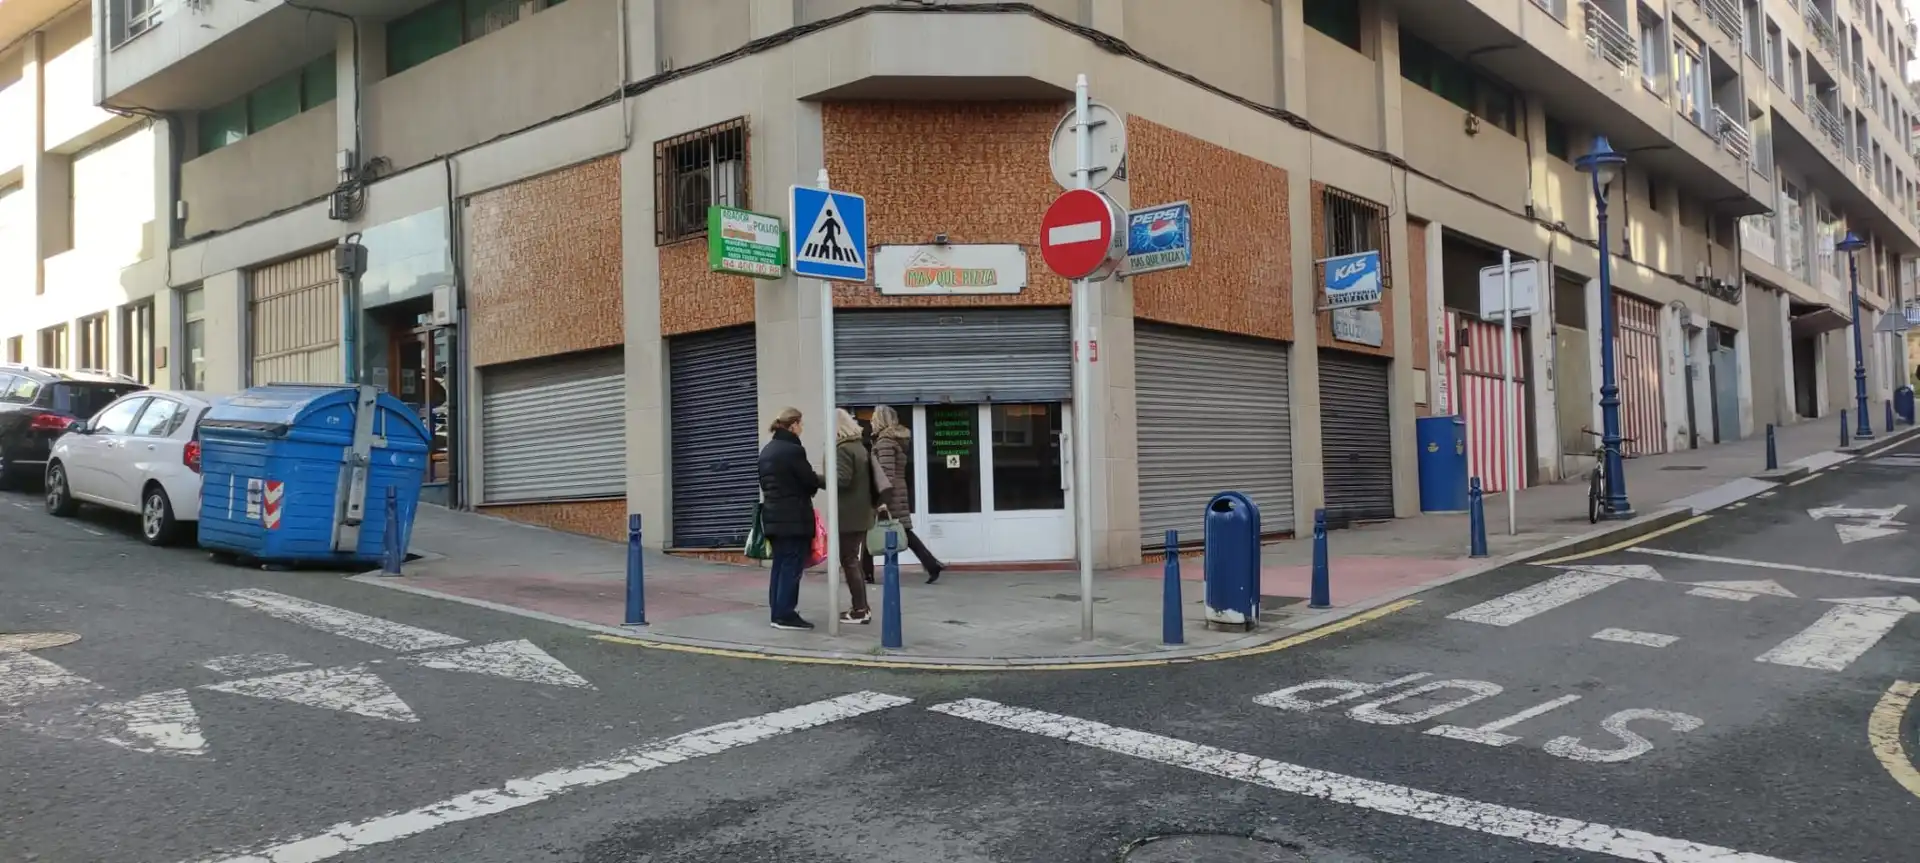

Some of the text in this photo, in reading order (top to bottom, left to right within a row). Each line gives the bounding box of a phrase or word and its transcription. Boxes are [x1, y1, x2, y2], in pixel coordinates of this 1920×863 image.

[1131, 207, 1180, 226] PEPSI
[1145, 253, 1160, 265] QUE
[908, 269, 996, 285] MAS QUE PIZZA
[1335, 258, 1366, 281] KAS
[1252, 671, 1705, 764] STOP
